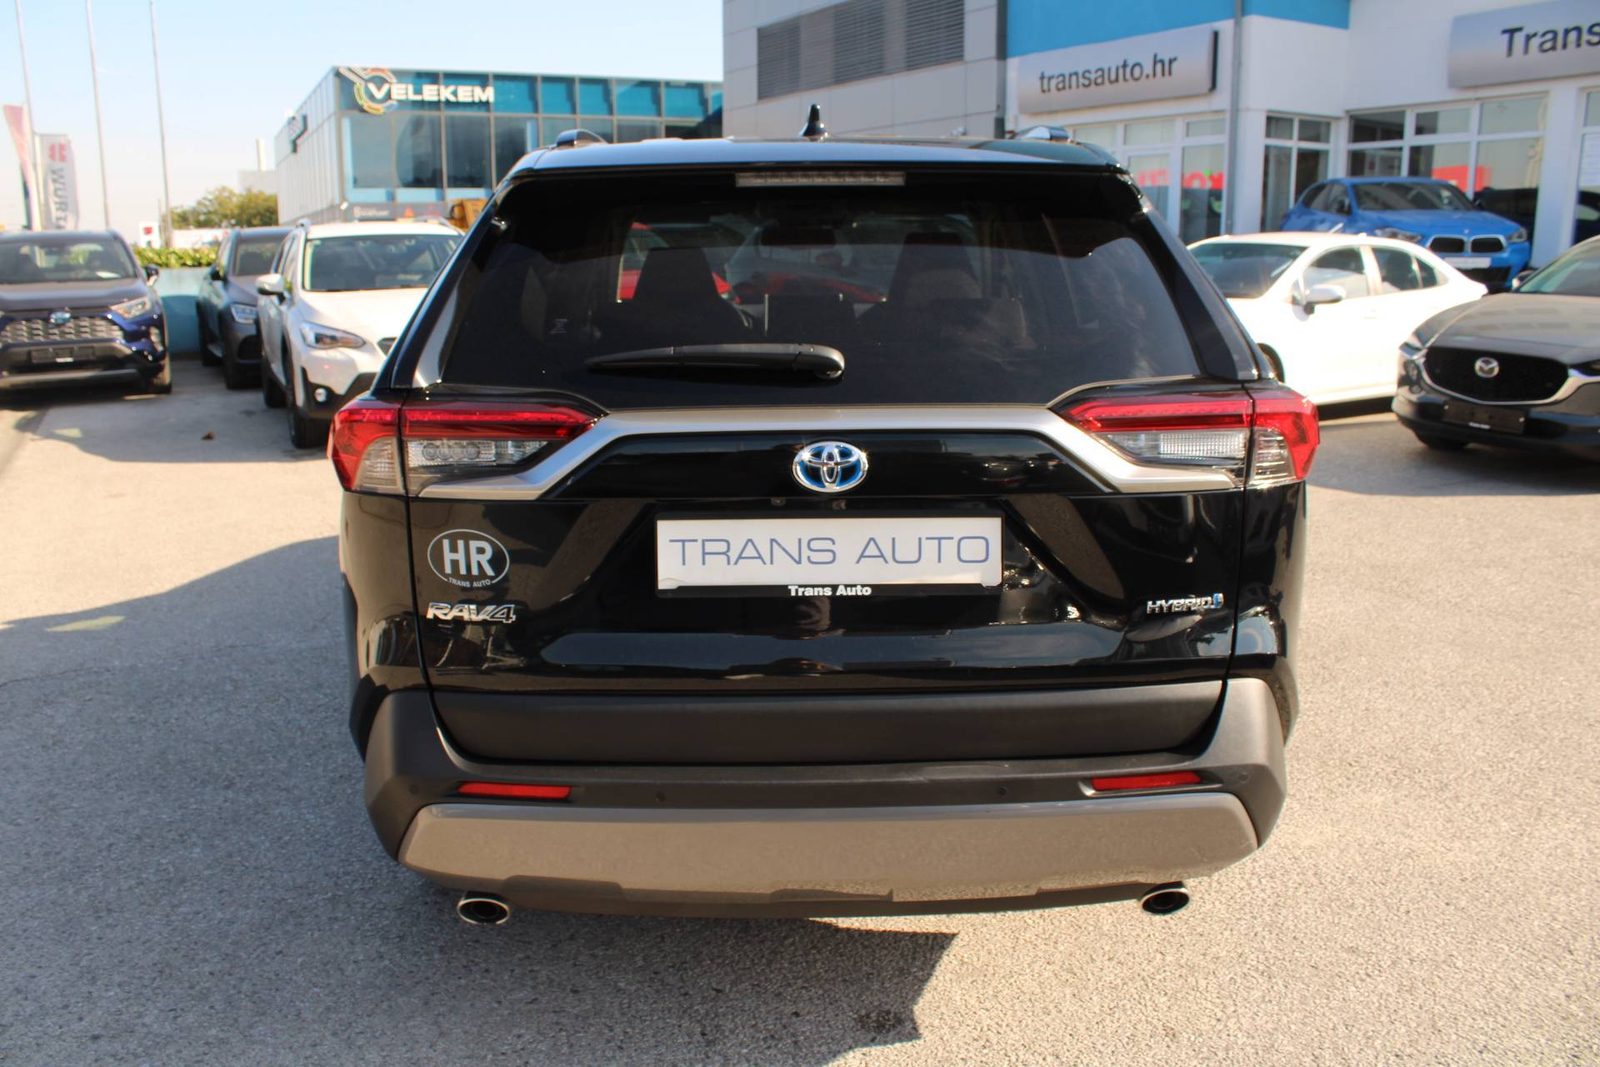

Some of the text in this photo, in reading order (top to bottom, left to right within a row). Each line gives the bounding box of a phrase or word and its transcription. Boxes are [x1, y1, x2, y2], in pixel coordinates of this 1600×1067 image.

[1501, 22, 1600, 58] Trans
[1039, 53, 1177, 93] transauto.hr
[367, 82, 494, 103] VELEKEM
[442, 539, 495, 576] HR
[669, 536, 991, 566] TRANS AUTO
[448, 577, 491, 588] TRANS AUTO
[788, 585, 872, 596] Trans Auto
[426, 602, 516, 623] RAV4
[1146, 596, 1212, 614] HYBRID
